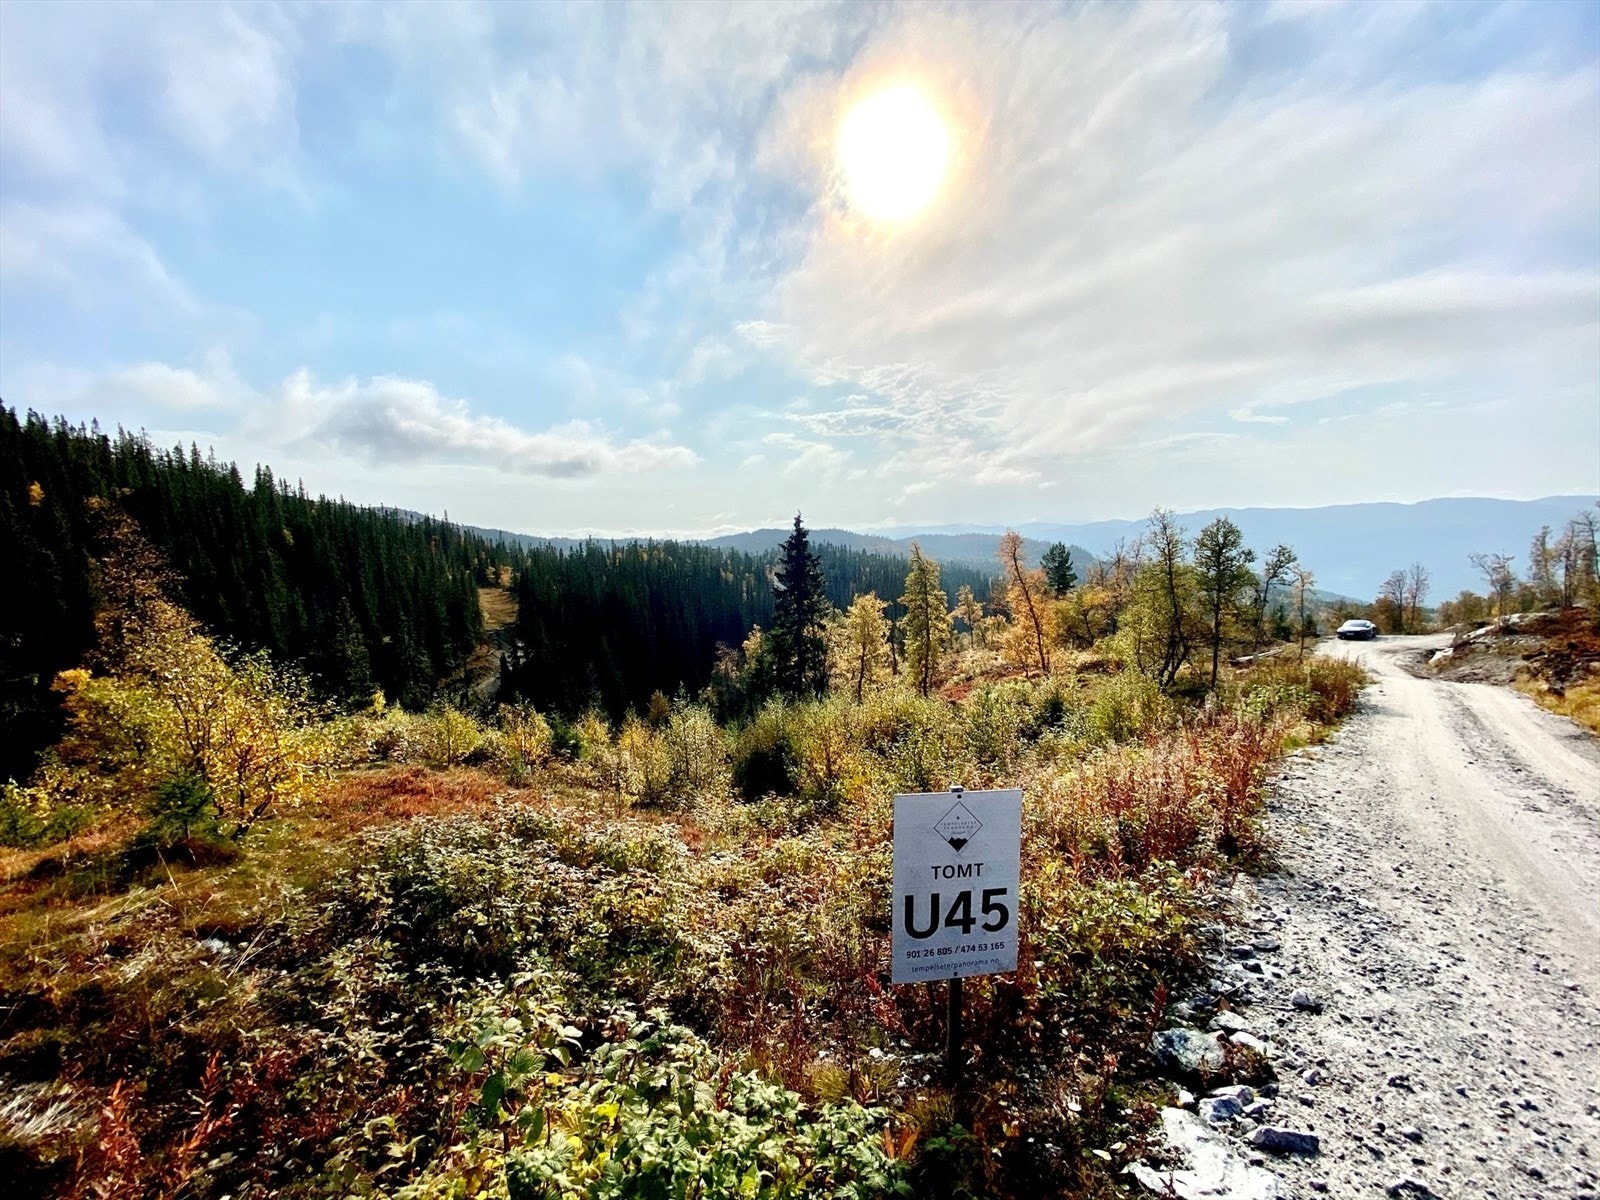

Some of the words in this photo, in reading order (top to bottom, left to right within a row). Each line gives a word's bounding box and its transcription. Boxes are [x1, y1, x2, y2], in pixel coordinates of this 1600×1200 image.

[931, 863, 984, 879] TOMT
[904, 887, 1009, 939] U45
[906, 950, 922, 959] 901
[923, 948, 935, 957] 26
[936, 947, 953, 956] 805
[960, 944, 977, 953] 474
[978, 942, 988, 952] 53
[990, 941, 1005, 950] 165
